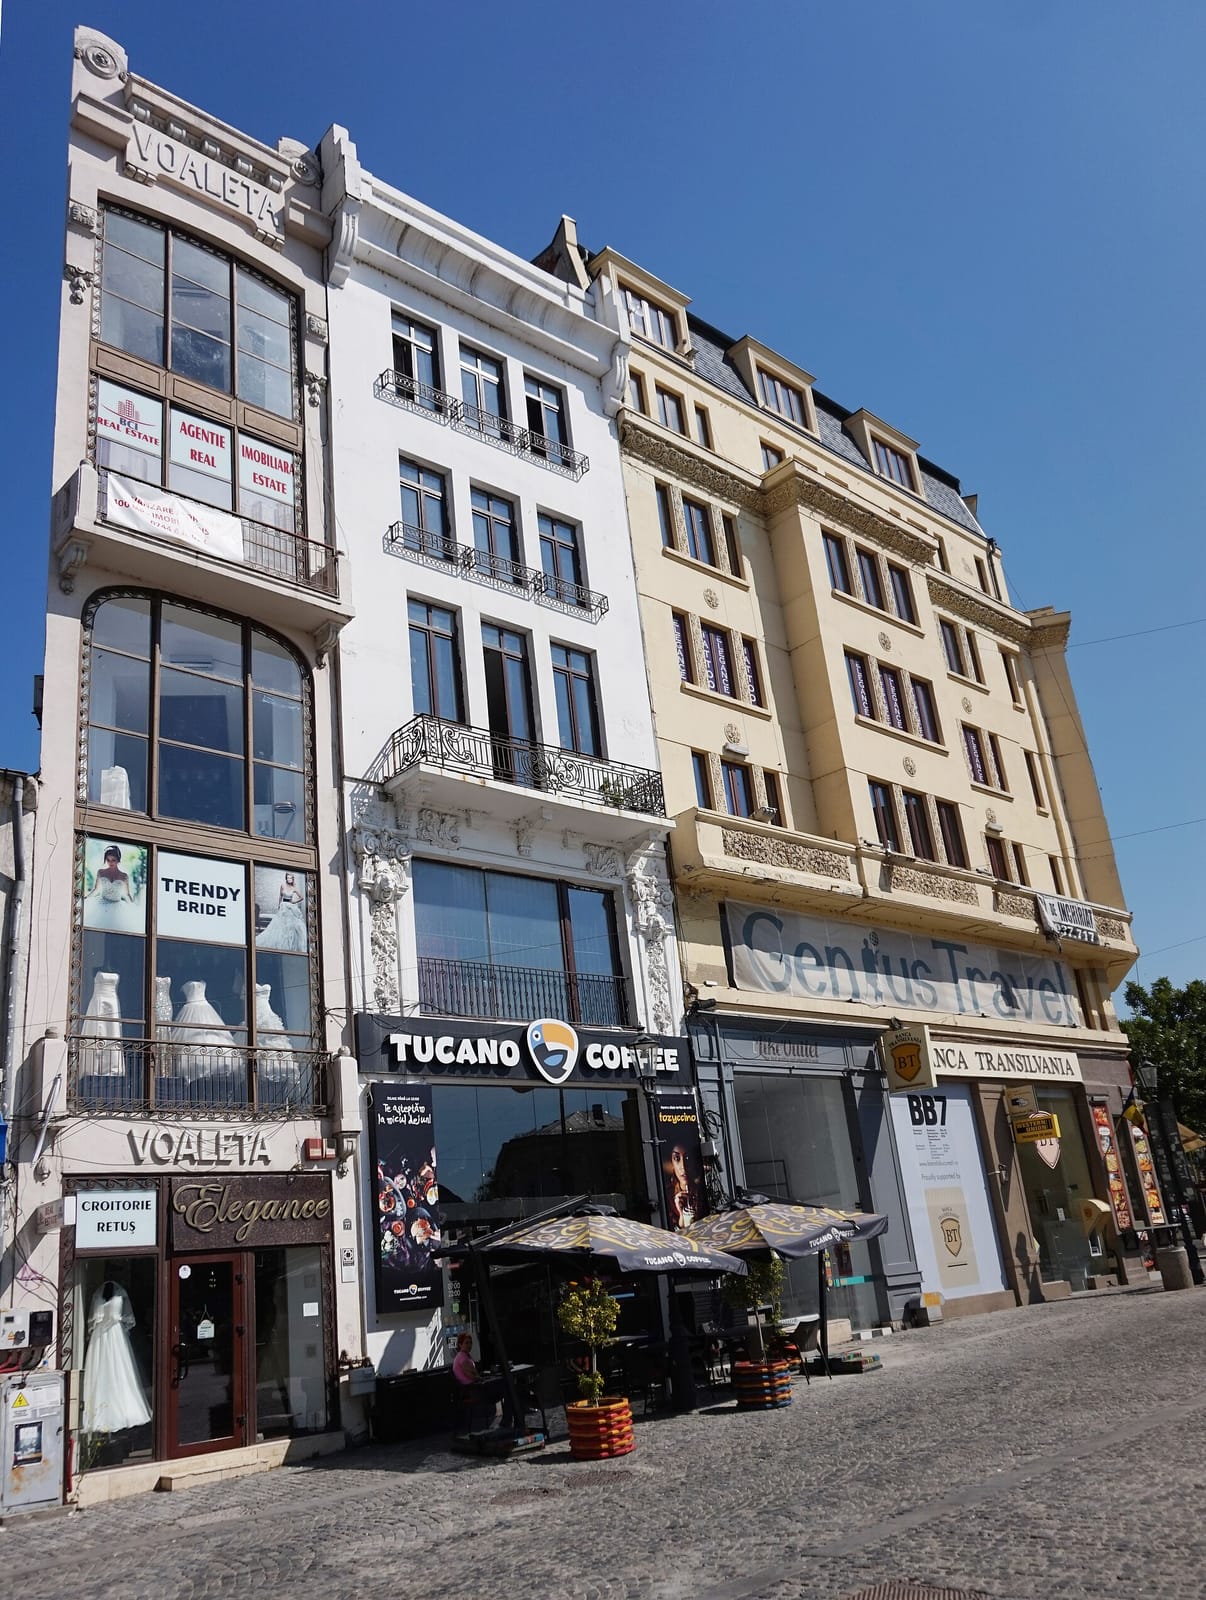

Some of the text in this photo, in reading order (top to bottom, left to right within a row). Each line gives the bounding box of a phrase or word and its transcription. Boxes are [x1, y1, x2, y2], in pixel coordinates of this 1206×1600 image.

[131, 122, 279, 229] VOALETA
[97, 416, 160, 447] REAL ESTATE
[119, 417, 139, 431] BCI
[179, 421, 226, 449] AGENTIE
[190, 448, 217, 469] REAL
[252, 471, 288, 495] ESTATE
[716, 634, 731, 695] ELEGANCE
[161, 877, 241, 902] TRENDY
[177, 900, 227, 917] BRIDE
[742, 911, 1075, 1025] Genius Travel
[389, 1033, 521, 1068] TUCANO
[898, 1054, 916, 1069] BT
[933, 1047, 1075, 1077] NCA TRANSILVANIA
[906, 1094, 947, 1126] BB7
[126, 1128, 272, 1167] VOALETA
[81, 1200, 152, 1212] CROITORIE
[172, 1184, 331, 1242] Elegance
[808, 1233, 833, 1248] TUCANO
[945, 1228, 958, 1243] BT
[644, 1255, 674, 1265] TUCANO
